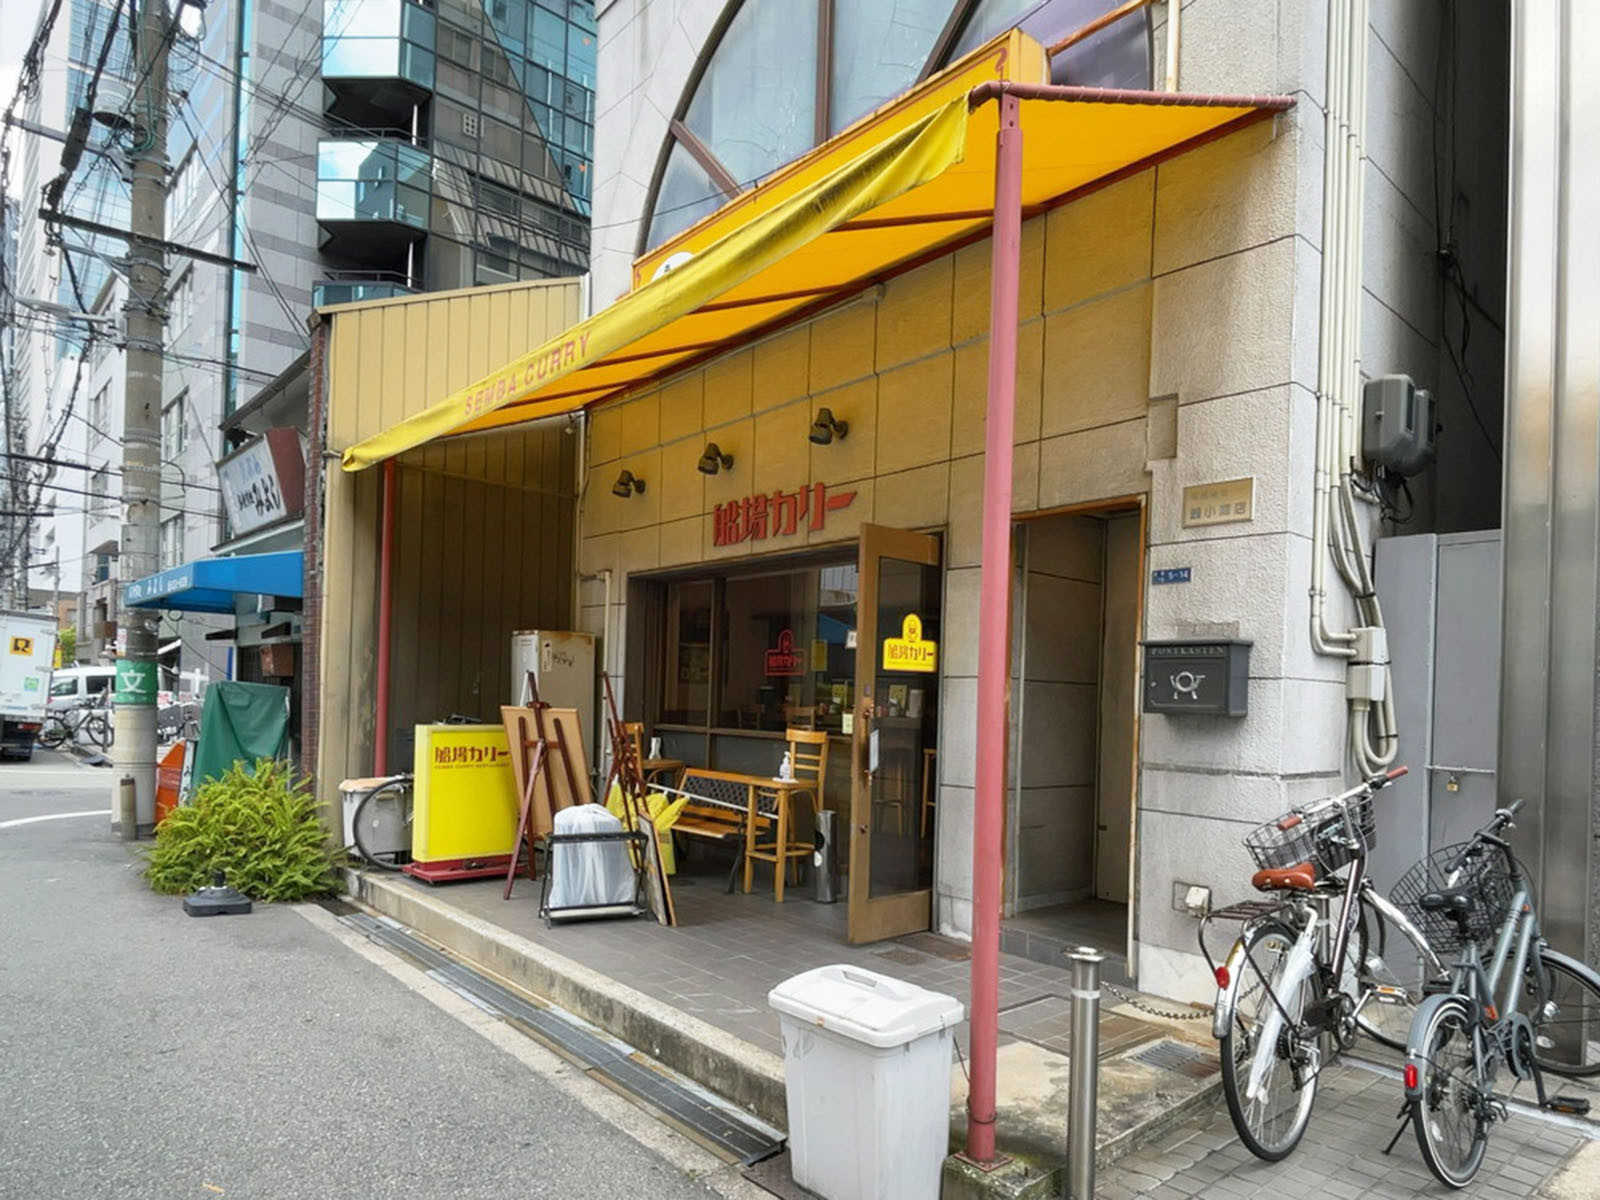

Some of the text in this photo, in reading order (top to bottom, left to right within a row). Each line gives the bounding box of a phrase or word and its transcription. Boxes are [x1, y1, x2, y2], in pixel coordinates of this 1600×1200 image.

[464, 331, 591, 415] SEMBA CURRY
[713, 482, 857, 546] 船場カリー
[1151, 646, 1224, 655] POSTKASTEN
[120, 669, 147, 693] 文
